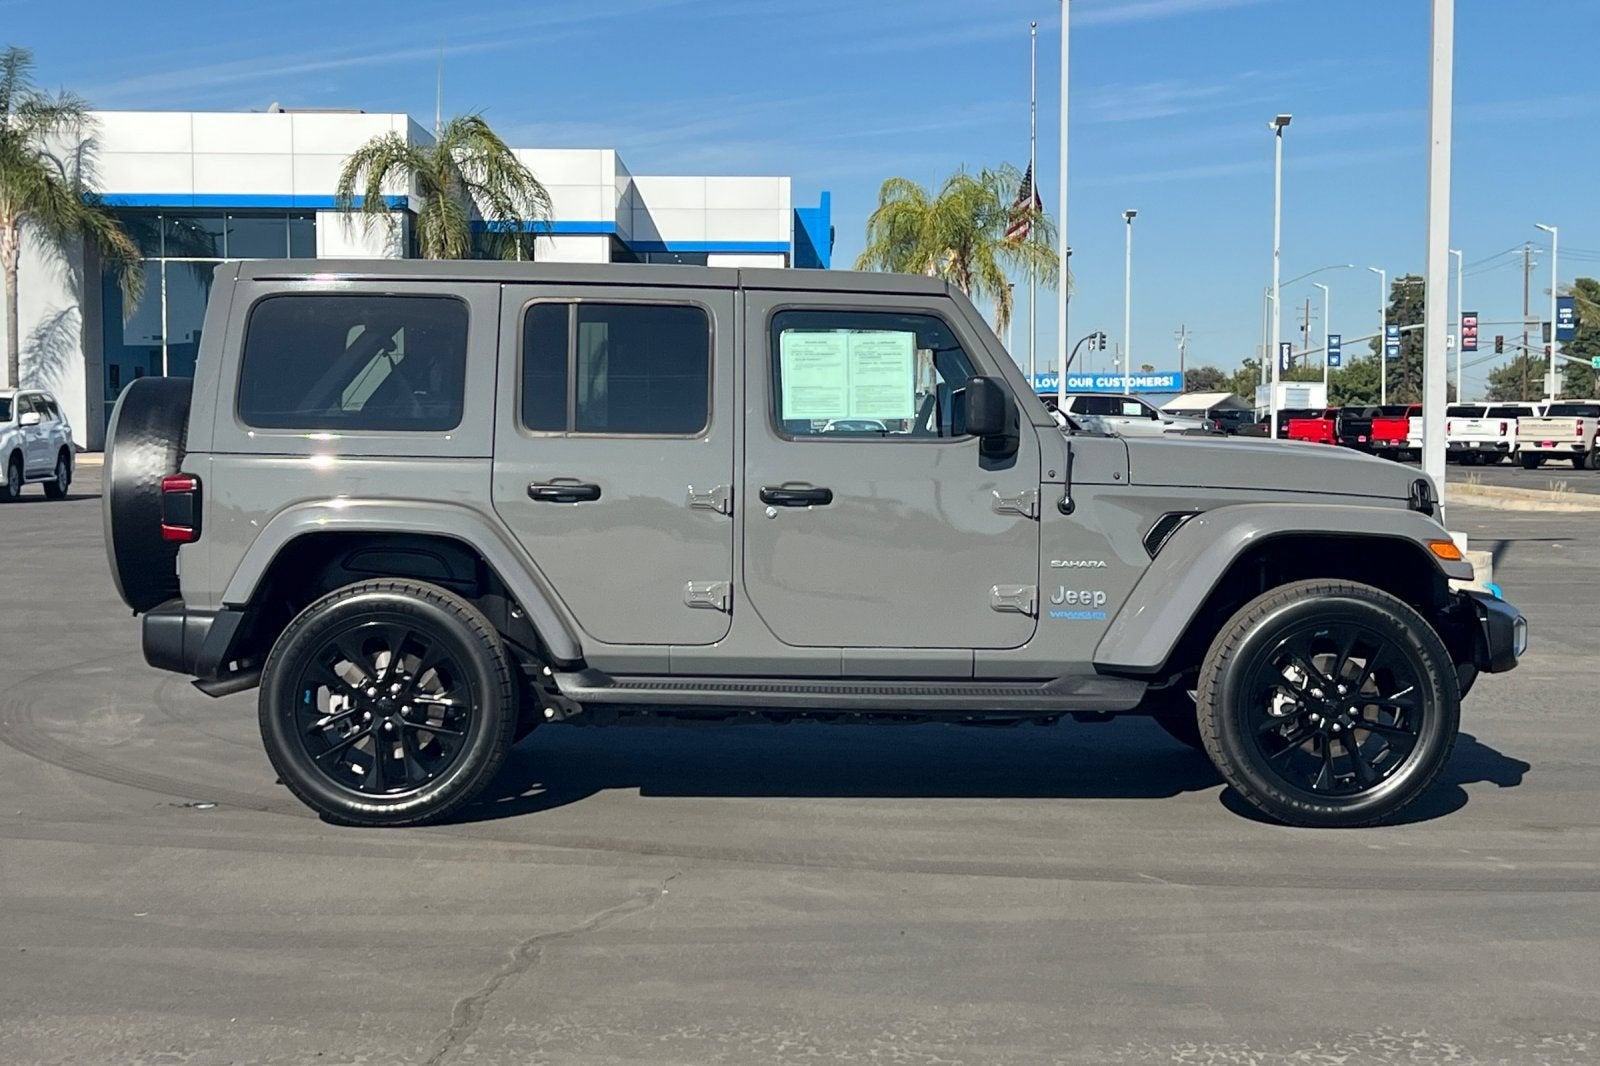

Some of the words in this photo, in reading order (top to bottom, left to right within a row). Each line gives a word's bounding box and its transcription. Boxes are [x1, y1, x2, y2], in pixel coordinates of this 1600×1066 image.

[1035, 377, 1060, 388] LOV
[1068, 377, 1093, 388] OUR
[1096, 376, 1174, 388] CUSTOMERS!
[1050, 560, 1107, 568] SAHARA
[1050, 585, 1107, 609] Jeep
